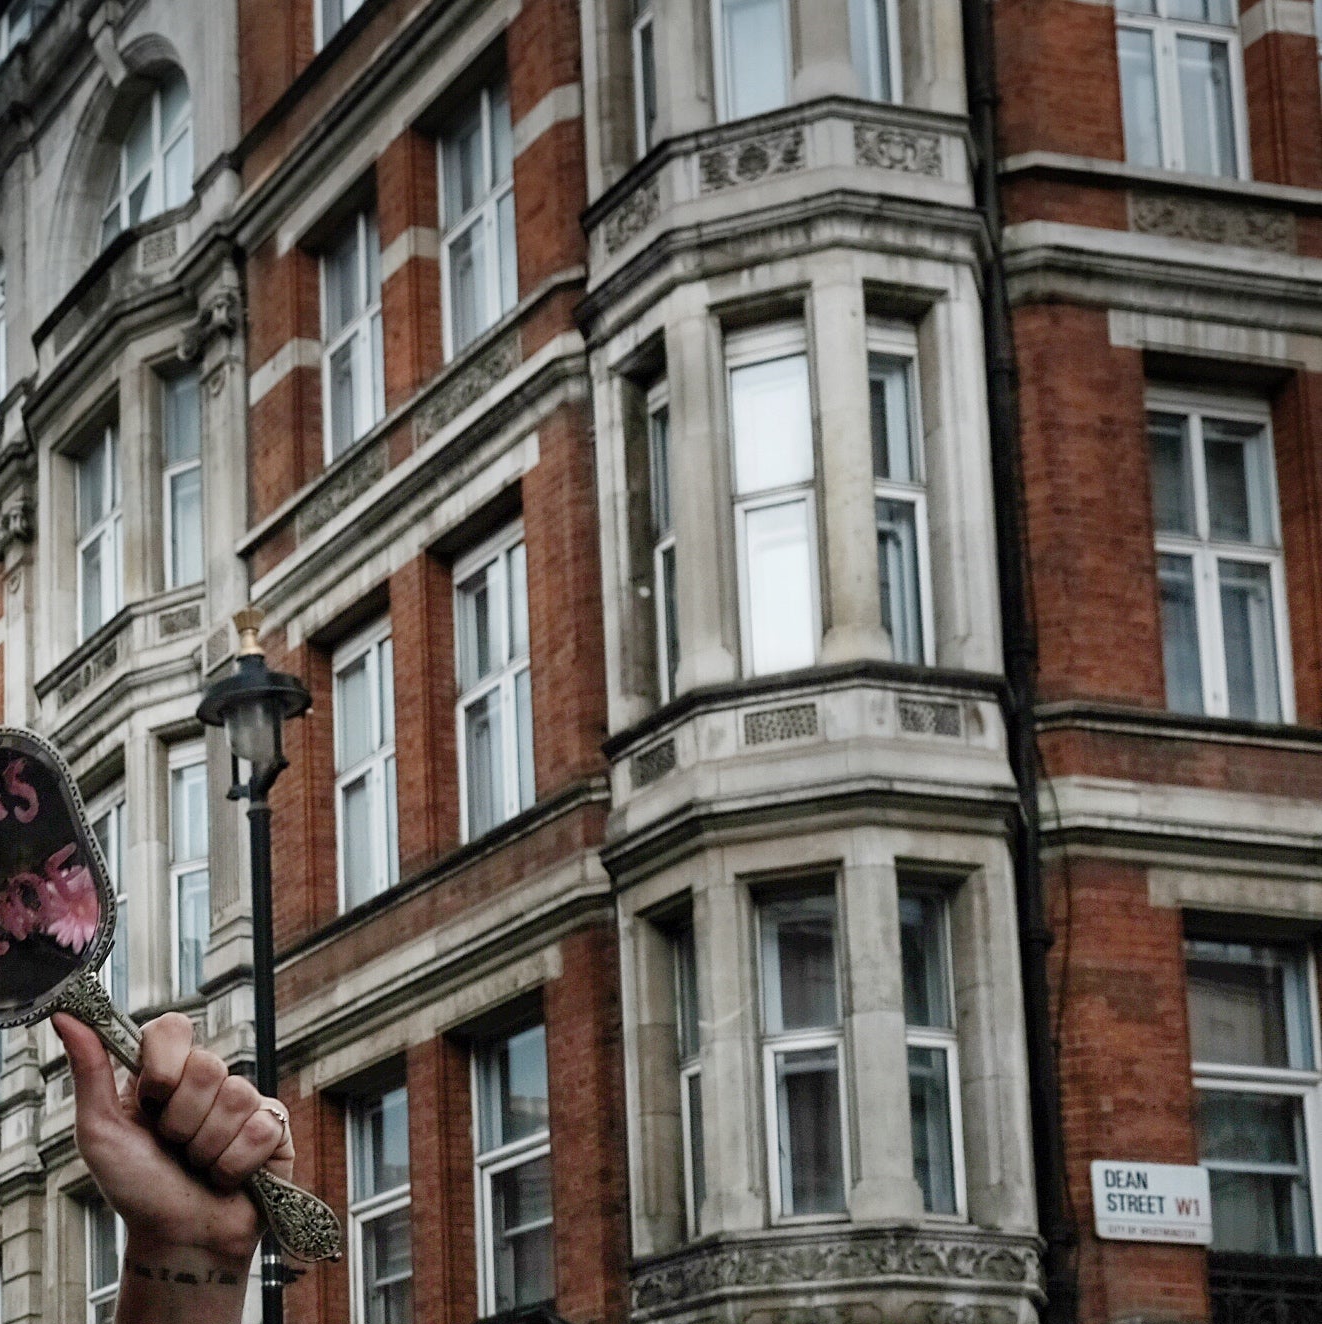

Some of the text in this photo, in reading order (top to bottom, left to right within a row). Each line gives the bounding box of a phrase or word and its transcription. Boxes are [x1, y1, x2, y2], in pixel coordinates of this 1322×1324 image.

[1104, 1169, 1148, 1190] DEAN
[1106, 1193, 1200, 1216] STREET W1
